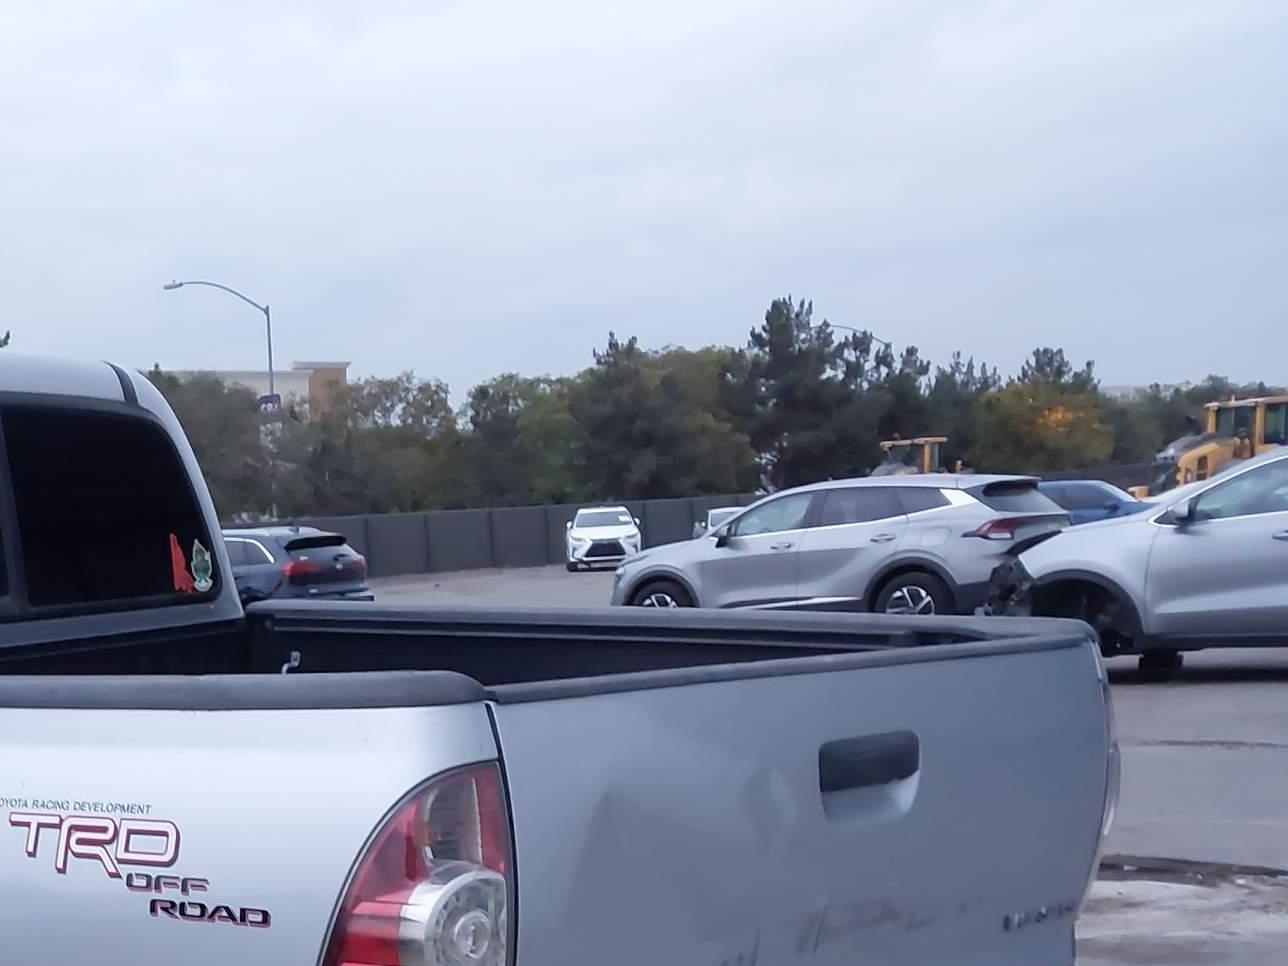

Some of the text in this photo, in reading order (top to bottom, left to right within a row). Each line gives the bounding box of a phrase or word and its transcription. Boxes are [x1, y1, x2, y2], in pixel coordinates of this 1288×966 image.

[31, 799, 71, 812] RACING
[72, 801, 152, 815] DEVELOPMENT
[8, 811, 181, 879] TRD
[125, 872, 209, 896] OFF
[149, 899, 272, 928] ROAD
